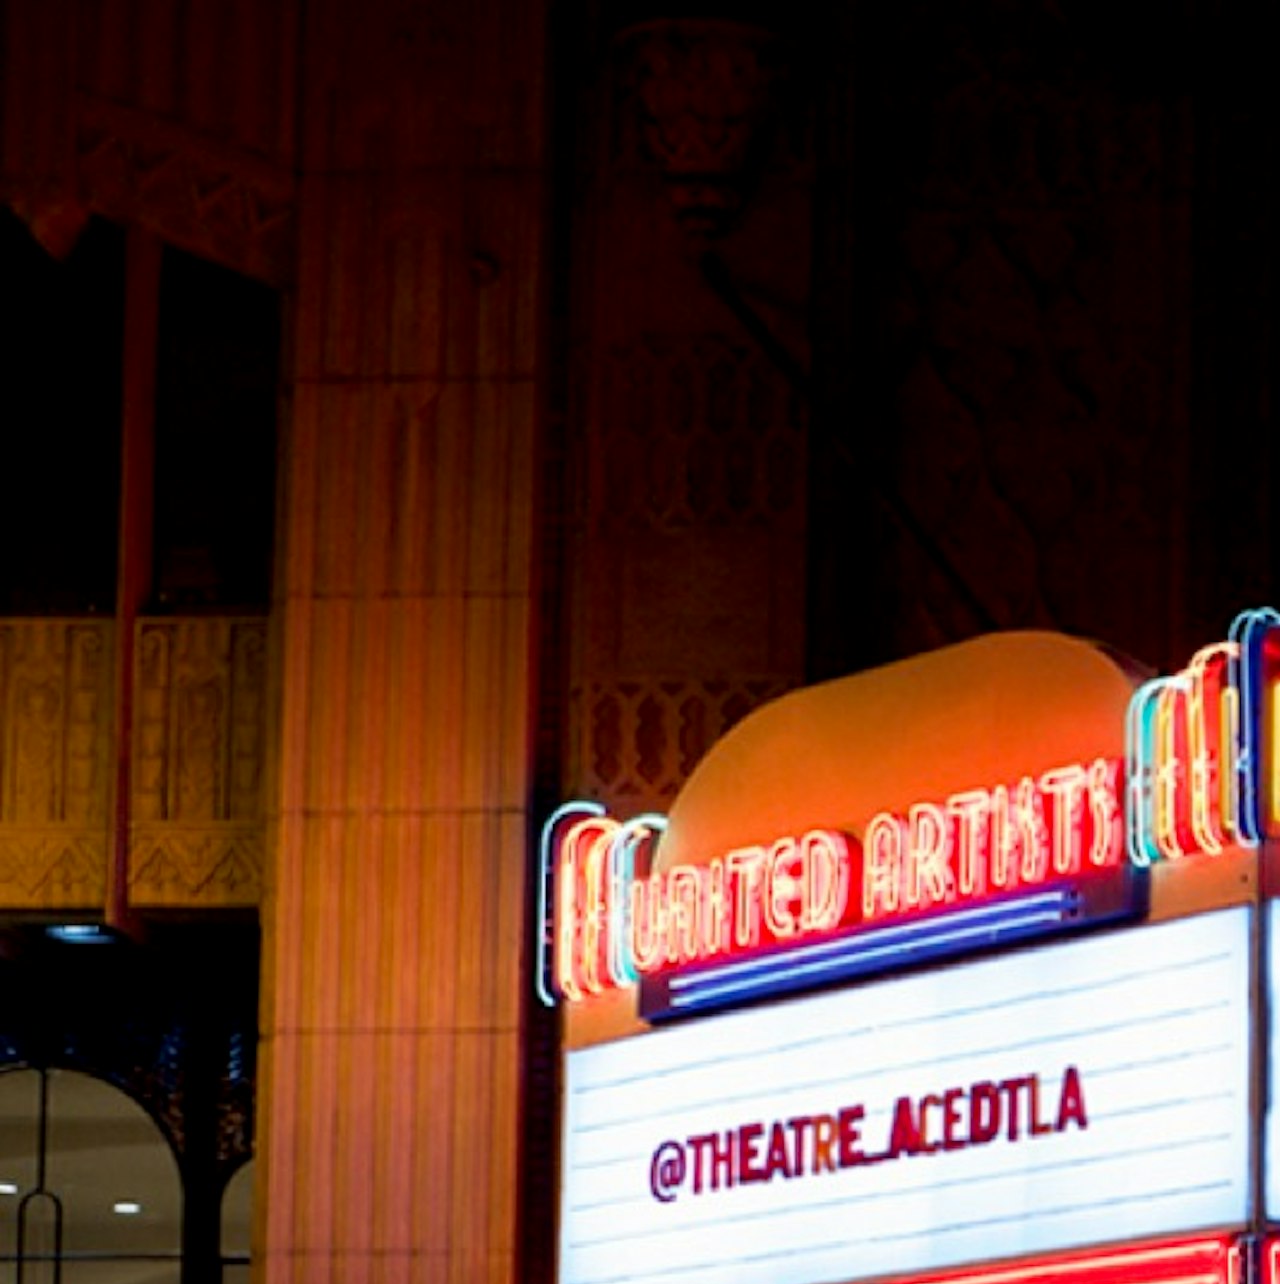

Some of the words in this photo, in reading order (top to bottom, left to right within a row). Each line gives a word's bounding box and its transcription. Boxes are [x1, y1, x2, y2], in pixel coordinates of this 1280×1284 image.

[630, 829, 849, 970] UNITED
[862, 757, 1116, 918] ARTISTS
[649, 1065, 1088, 1202] @THEATRE_ACEDTLA
